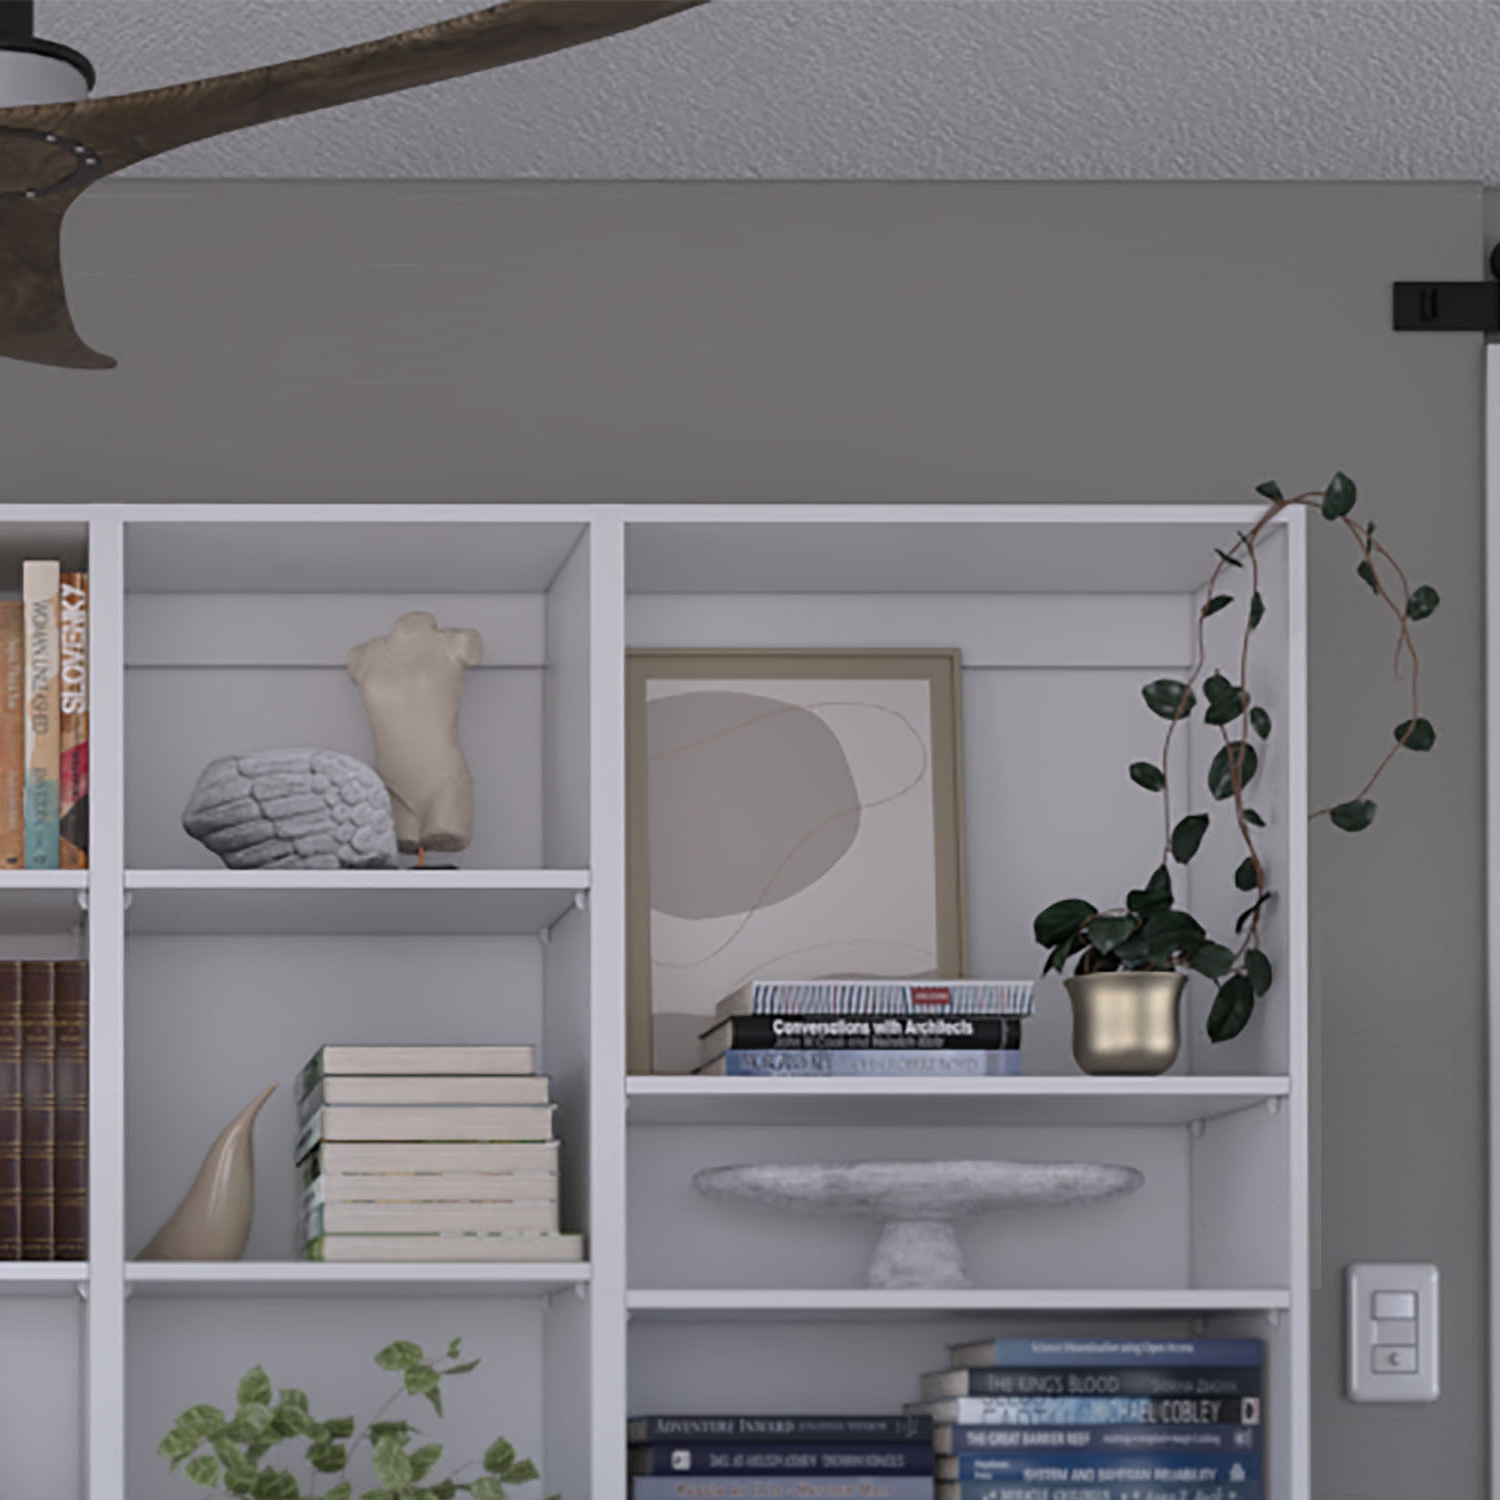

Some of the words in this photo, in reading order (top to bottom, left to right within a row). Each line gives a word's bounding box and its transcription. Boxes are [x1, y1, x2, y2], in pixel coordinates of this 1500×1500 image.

[773, 1019, 870, 1036] Conversations
[872, 1019, 902, 1036] with
[904, 1019, 973, 1036] Architects
[987, 1375, 1013, 1393] THE
[1068, 1375, 1121, 1393] BLOOD
[1162, 1401, 1221, 1424] COBLEY
[656, 1419, 735, 1434] ADVENTURE
[989, 1432, 1021, 1446] GREAT
[1067, 1432, 1091, 1446] REEF
